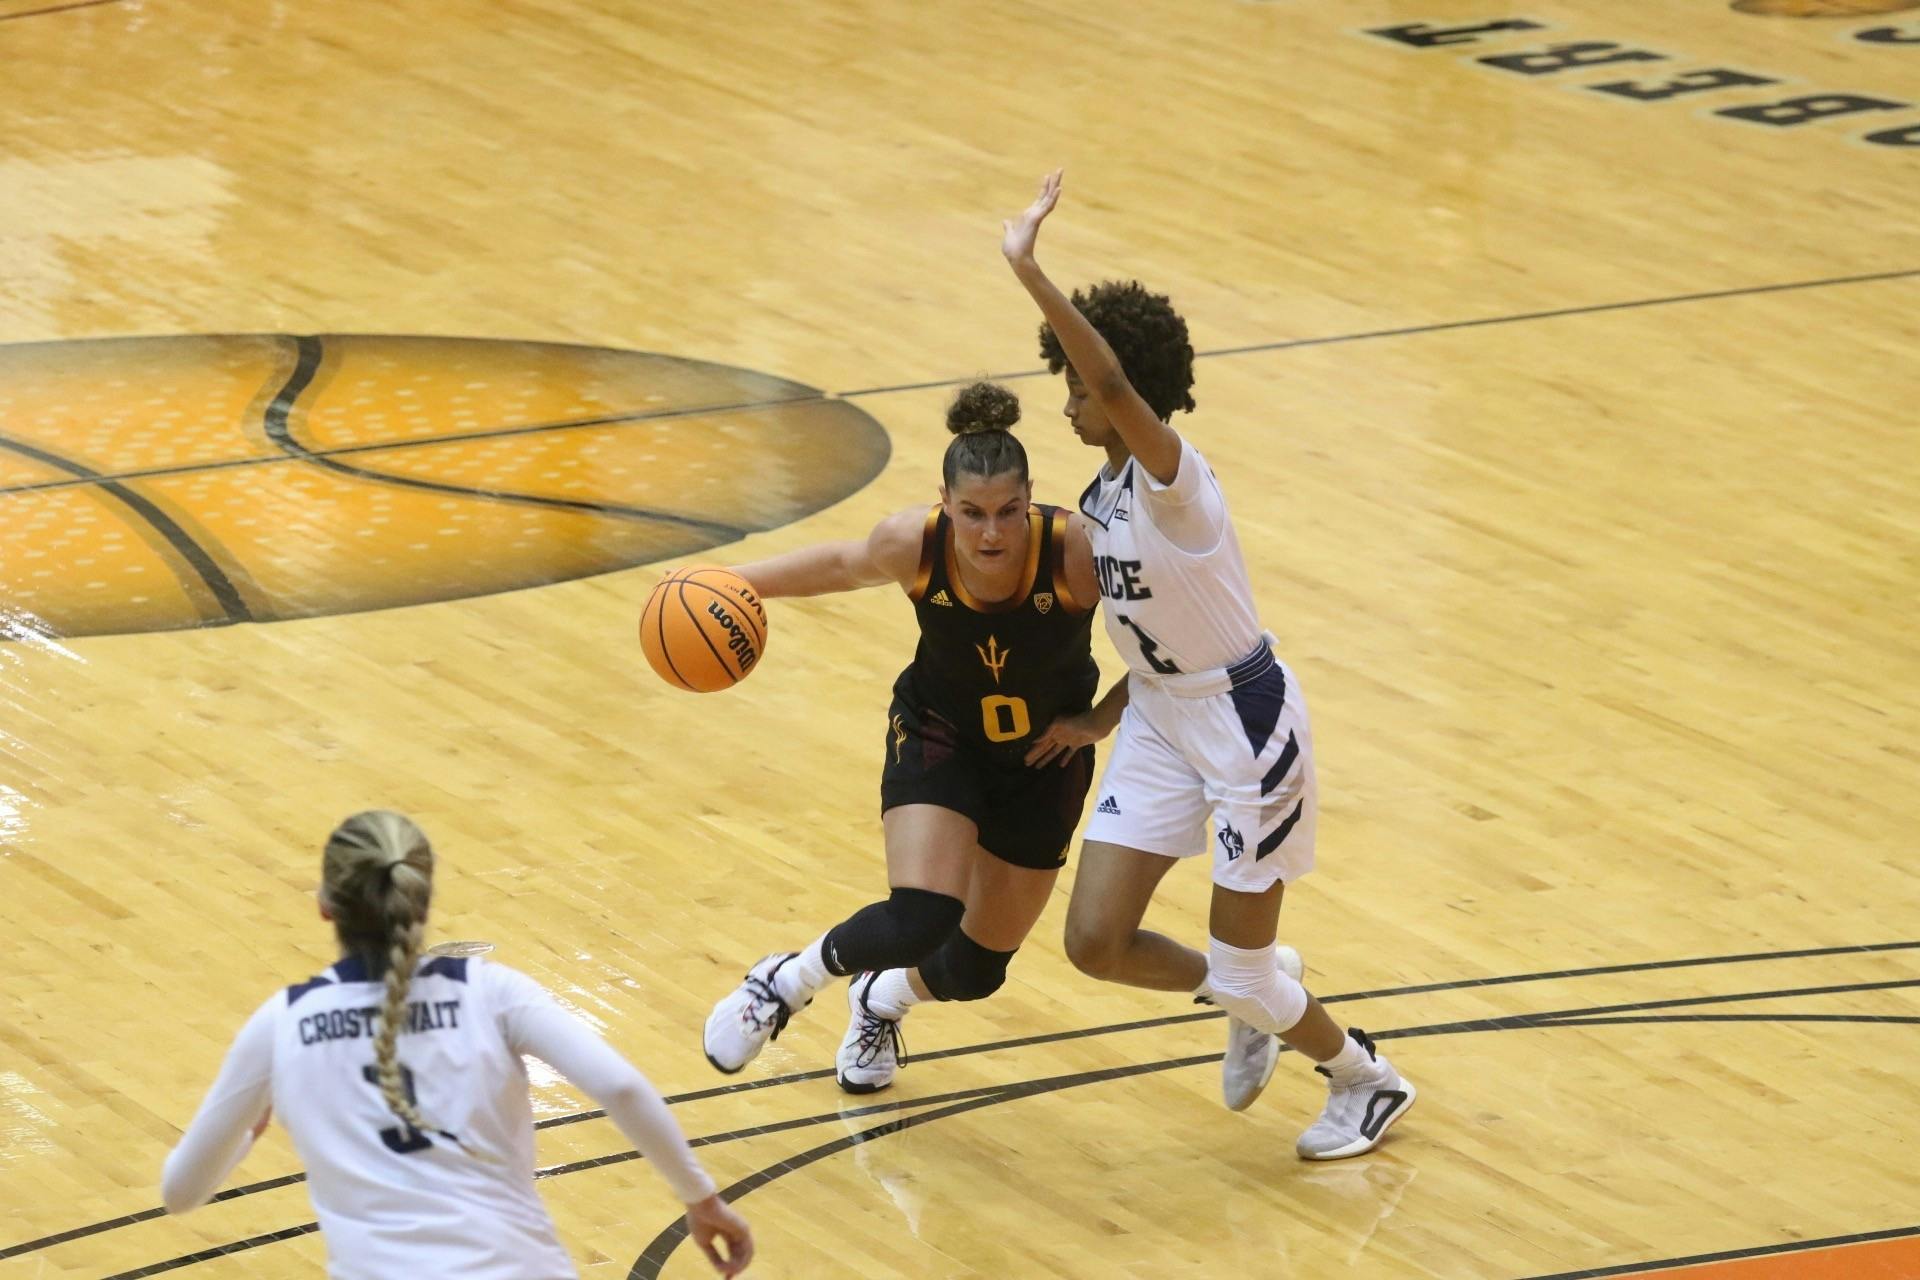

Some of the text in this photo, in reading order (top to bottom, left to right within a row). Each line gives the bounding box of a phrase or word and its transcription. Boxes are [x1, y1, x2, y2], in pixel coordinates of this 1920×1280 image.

[930, 598, 953, 607] adidas
[708, 600, 756, 673] Wilson
[1116, 614, 1184, 674] 2
[981, 694, 1031, 743] 0
[1097, 806, 1121, 815] adidas
[299, 1000, 460, 1046] CROSTWAIT
